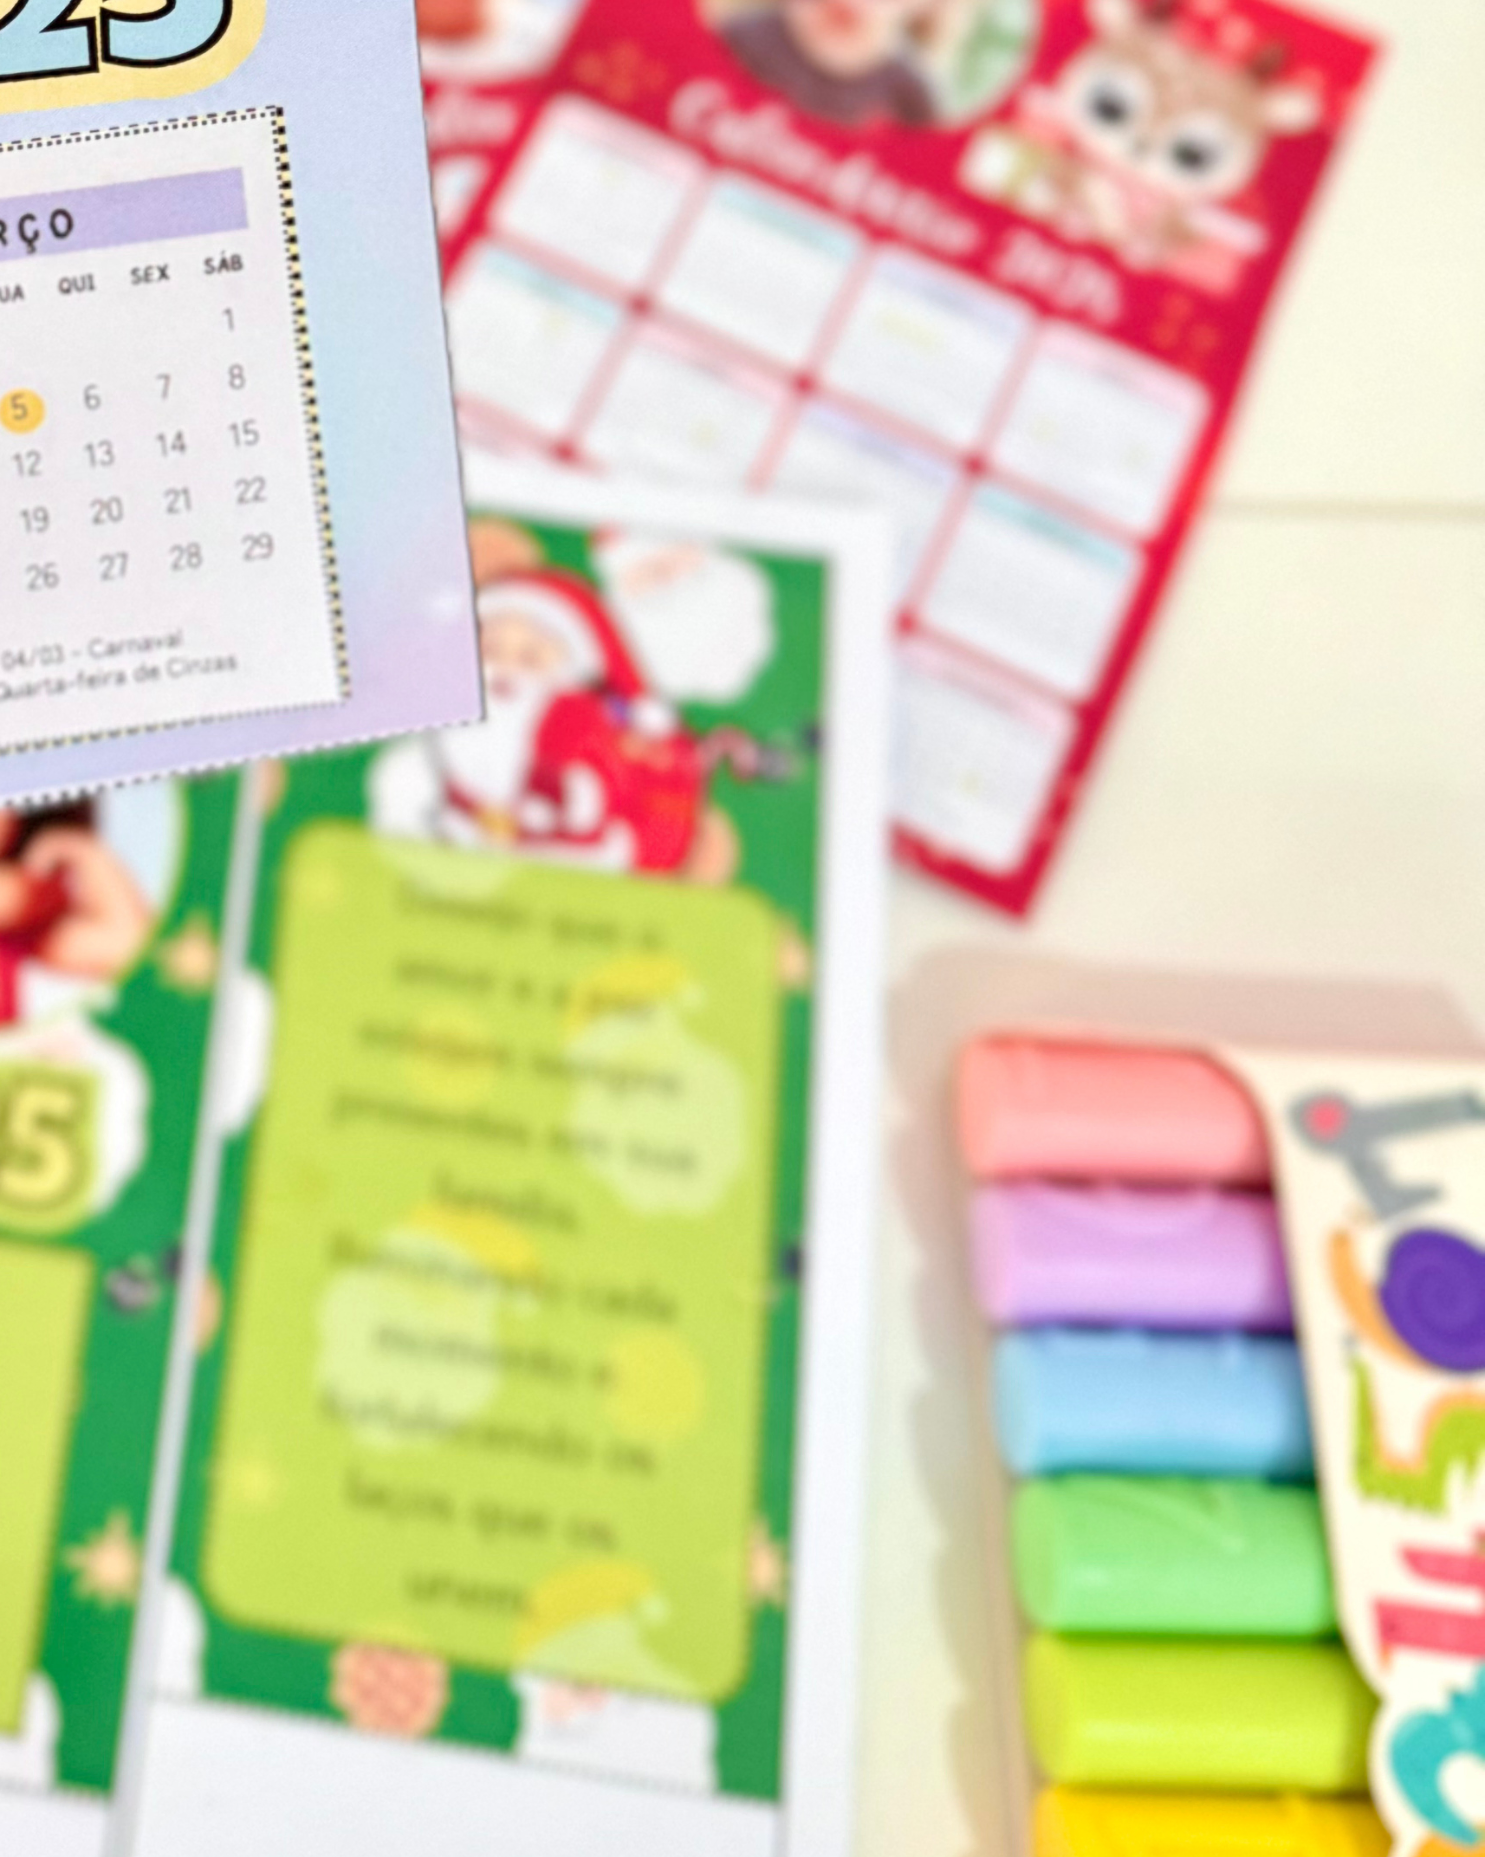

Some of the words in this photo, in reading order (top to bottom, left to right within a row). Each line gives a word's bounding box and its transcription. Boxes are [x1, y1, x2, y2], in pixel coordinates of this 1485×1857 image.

[58, 274, 95, 294] QUI
[130, 264, 170, 284] SEX
[204, 251, 243, 275] SÁB
[223, 308, 235, 331] 1
[12, 395, 28, 420] 5
[84, 385, 100, 410] 6
[157, 375, 172, 399] 7
[229, 364, 245, 390] 8
[13, 450, 41, 477] 12
[85, 440, 114, 468] 13
[157, 431, 187, 457] 14
[229, 420, 259, 447] 15
[20, 507, 49, 533] 19
[91, 497, 123, 524] 20
[164, 488, 192, 514] 21
[236, 477, 267, 504] 22
[27, 563, 59, 591] 26
[100, 553, 129, 581] 27
[171, 543, 202, 571] 28
[242, 533, 273, 561] 29
[1, 645, 64, 671] 04/03
[88, 631, 182, 659] Carnaval
[134, 664, 160, 683] de
[166, 655, 238, 678] Cinzas
